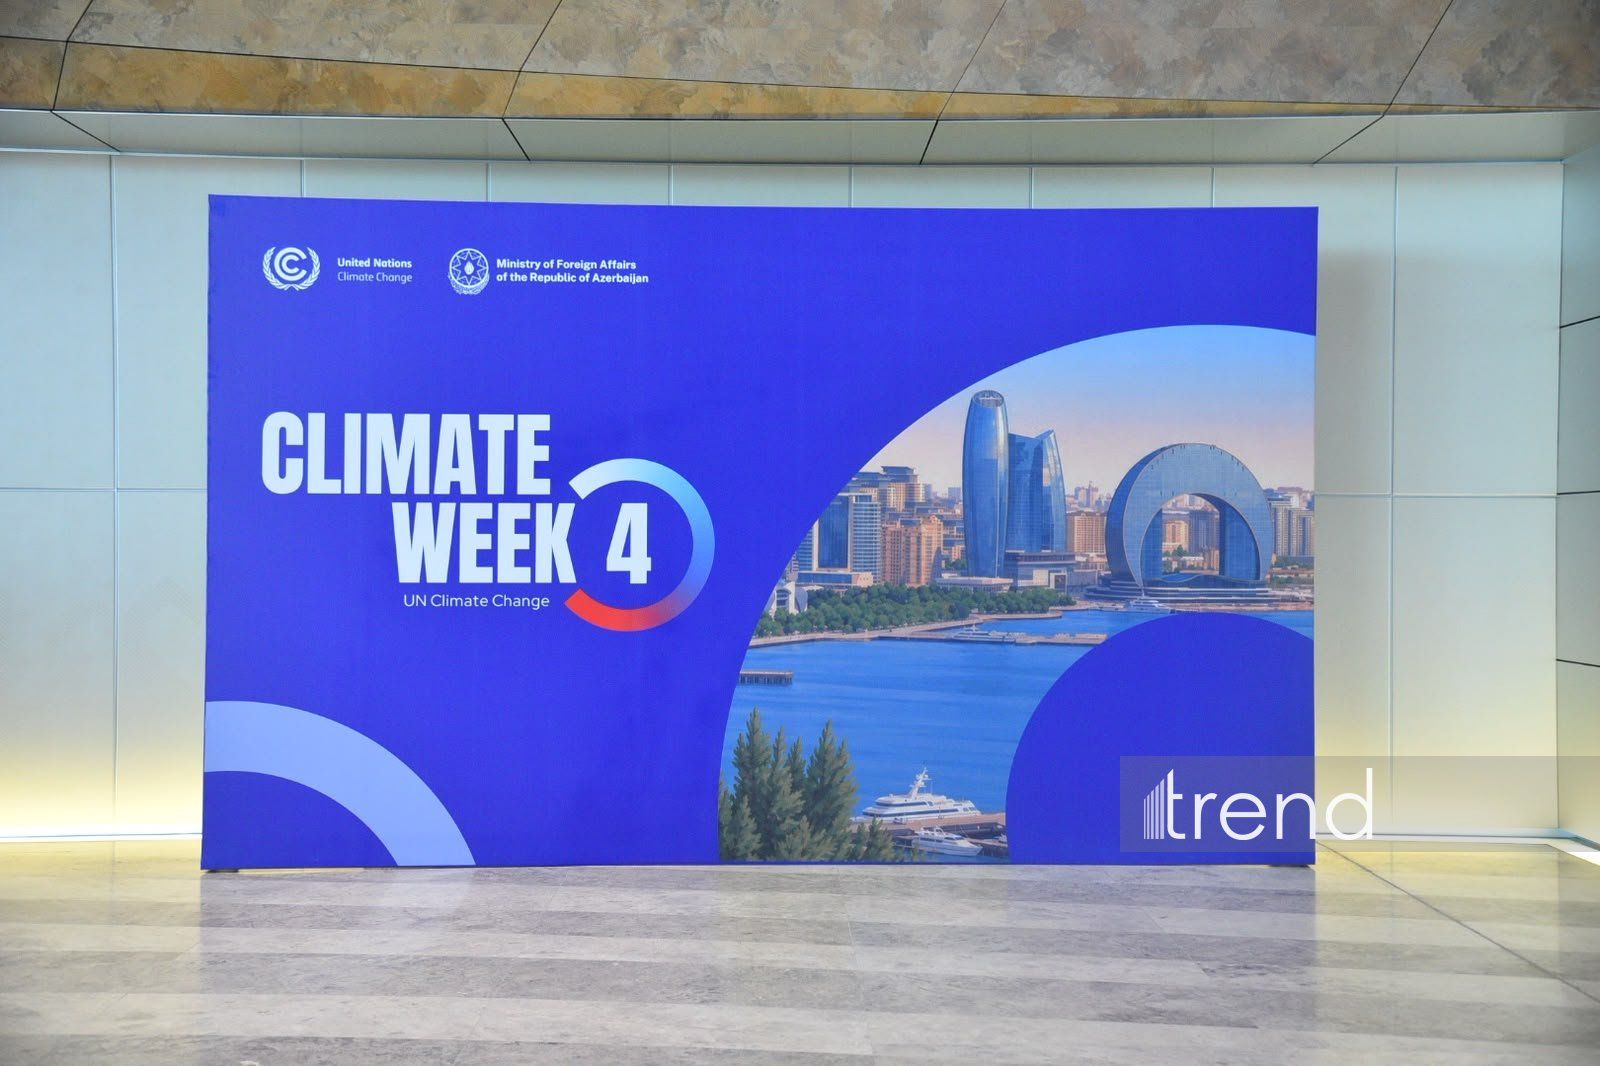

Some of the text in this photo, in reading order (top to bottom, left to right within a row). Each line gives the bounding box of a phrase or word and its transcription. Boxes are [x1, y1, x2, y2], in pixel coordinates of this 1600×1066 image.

[337, 257, 413, 268] United Nations
[496, 258, 637, 271] Ministry of Foreign Affairs
[337, 271, 413, 285] Climate Change
[496, 271, 649, 285] of the Republic of Azerbaijan
[261, 411, 551, 495] CLIMATE
[391, 501, 652, 585] WEEK 4
[403, 593, 550, 611] UN Climate Change
